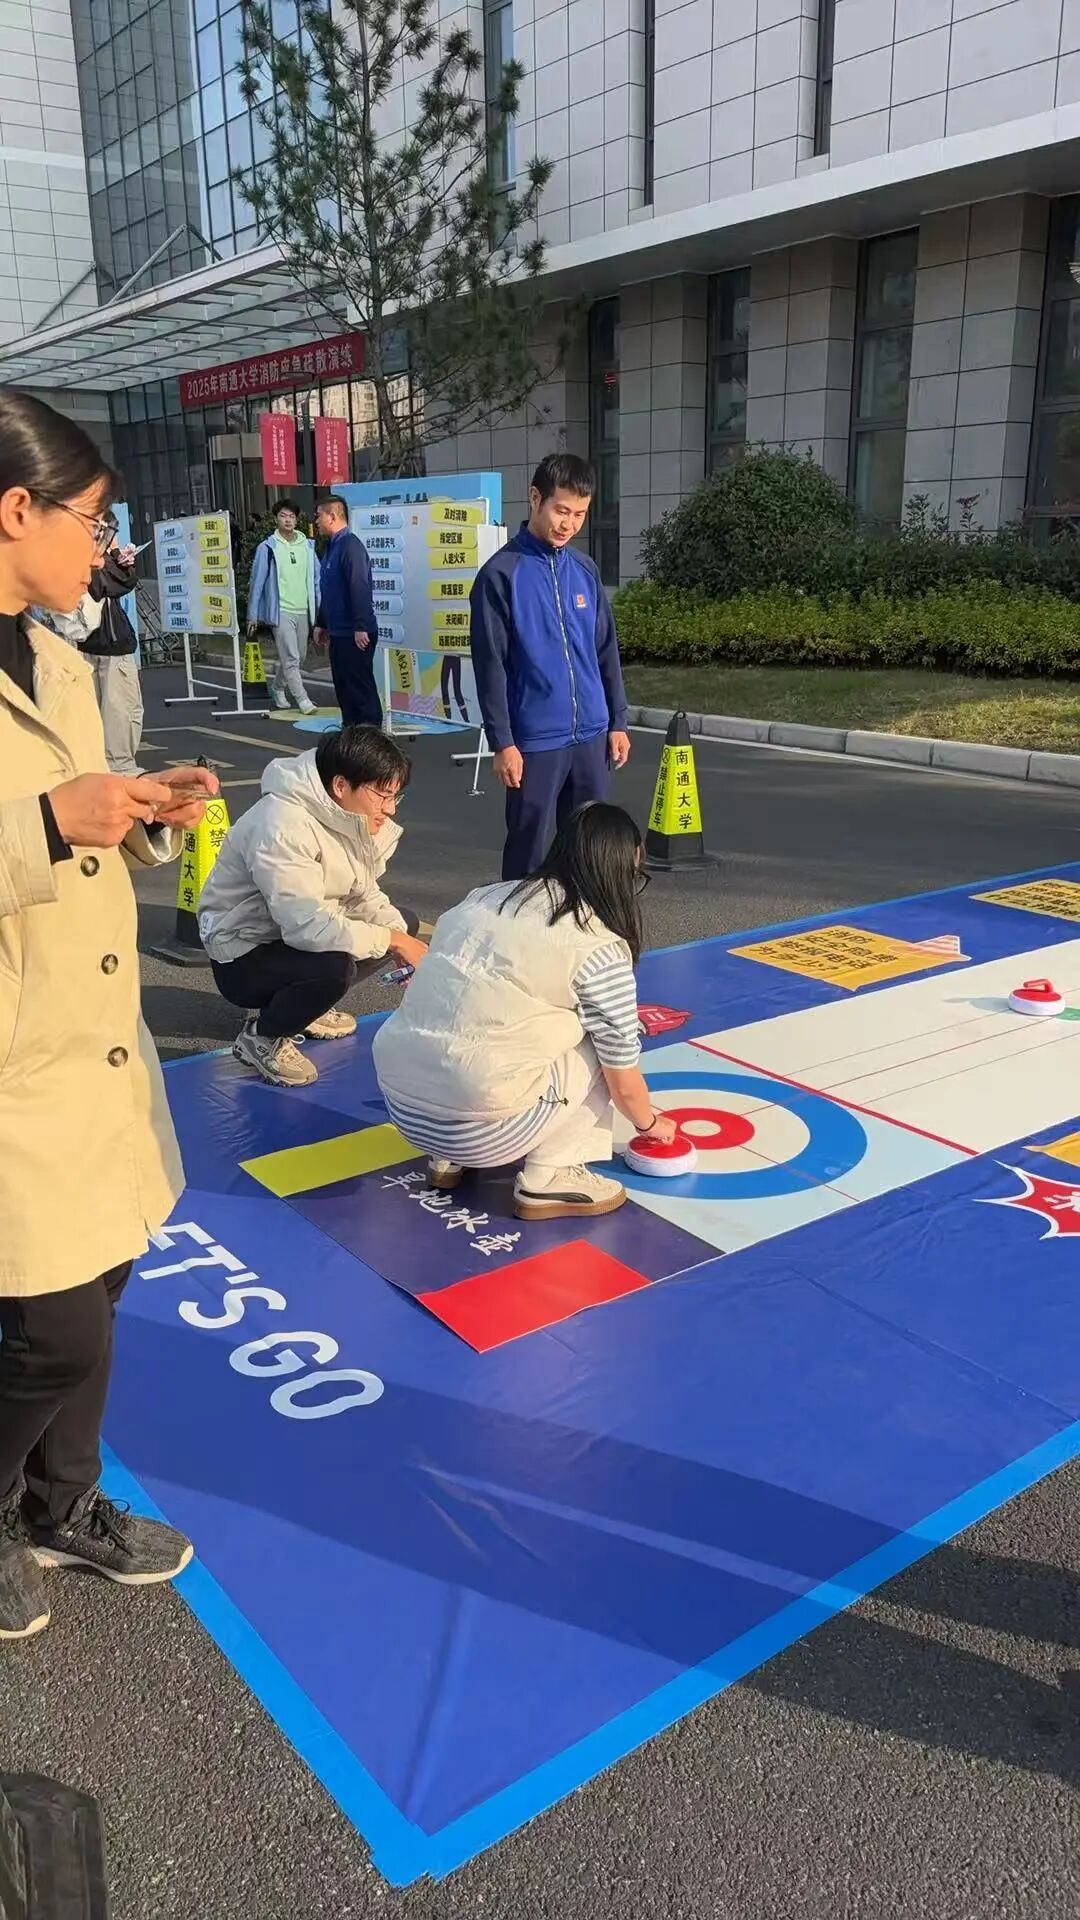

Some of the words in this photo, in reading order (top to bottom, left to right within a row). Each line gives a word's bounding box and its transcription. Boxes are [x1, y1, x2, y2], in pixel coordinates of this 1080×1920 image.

[187, 343, 353, 400] 2025年南通大学消防应急疏散演练
[653, 766, 668, 827] 禁止停车
[674, 749, 693, 830] 南通大学
[182, 832, 197, 908] 通大学
[380, 1171, 522, 1257] 旱地冰壶
[229, 1330, 385, 1420] GO
